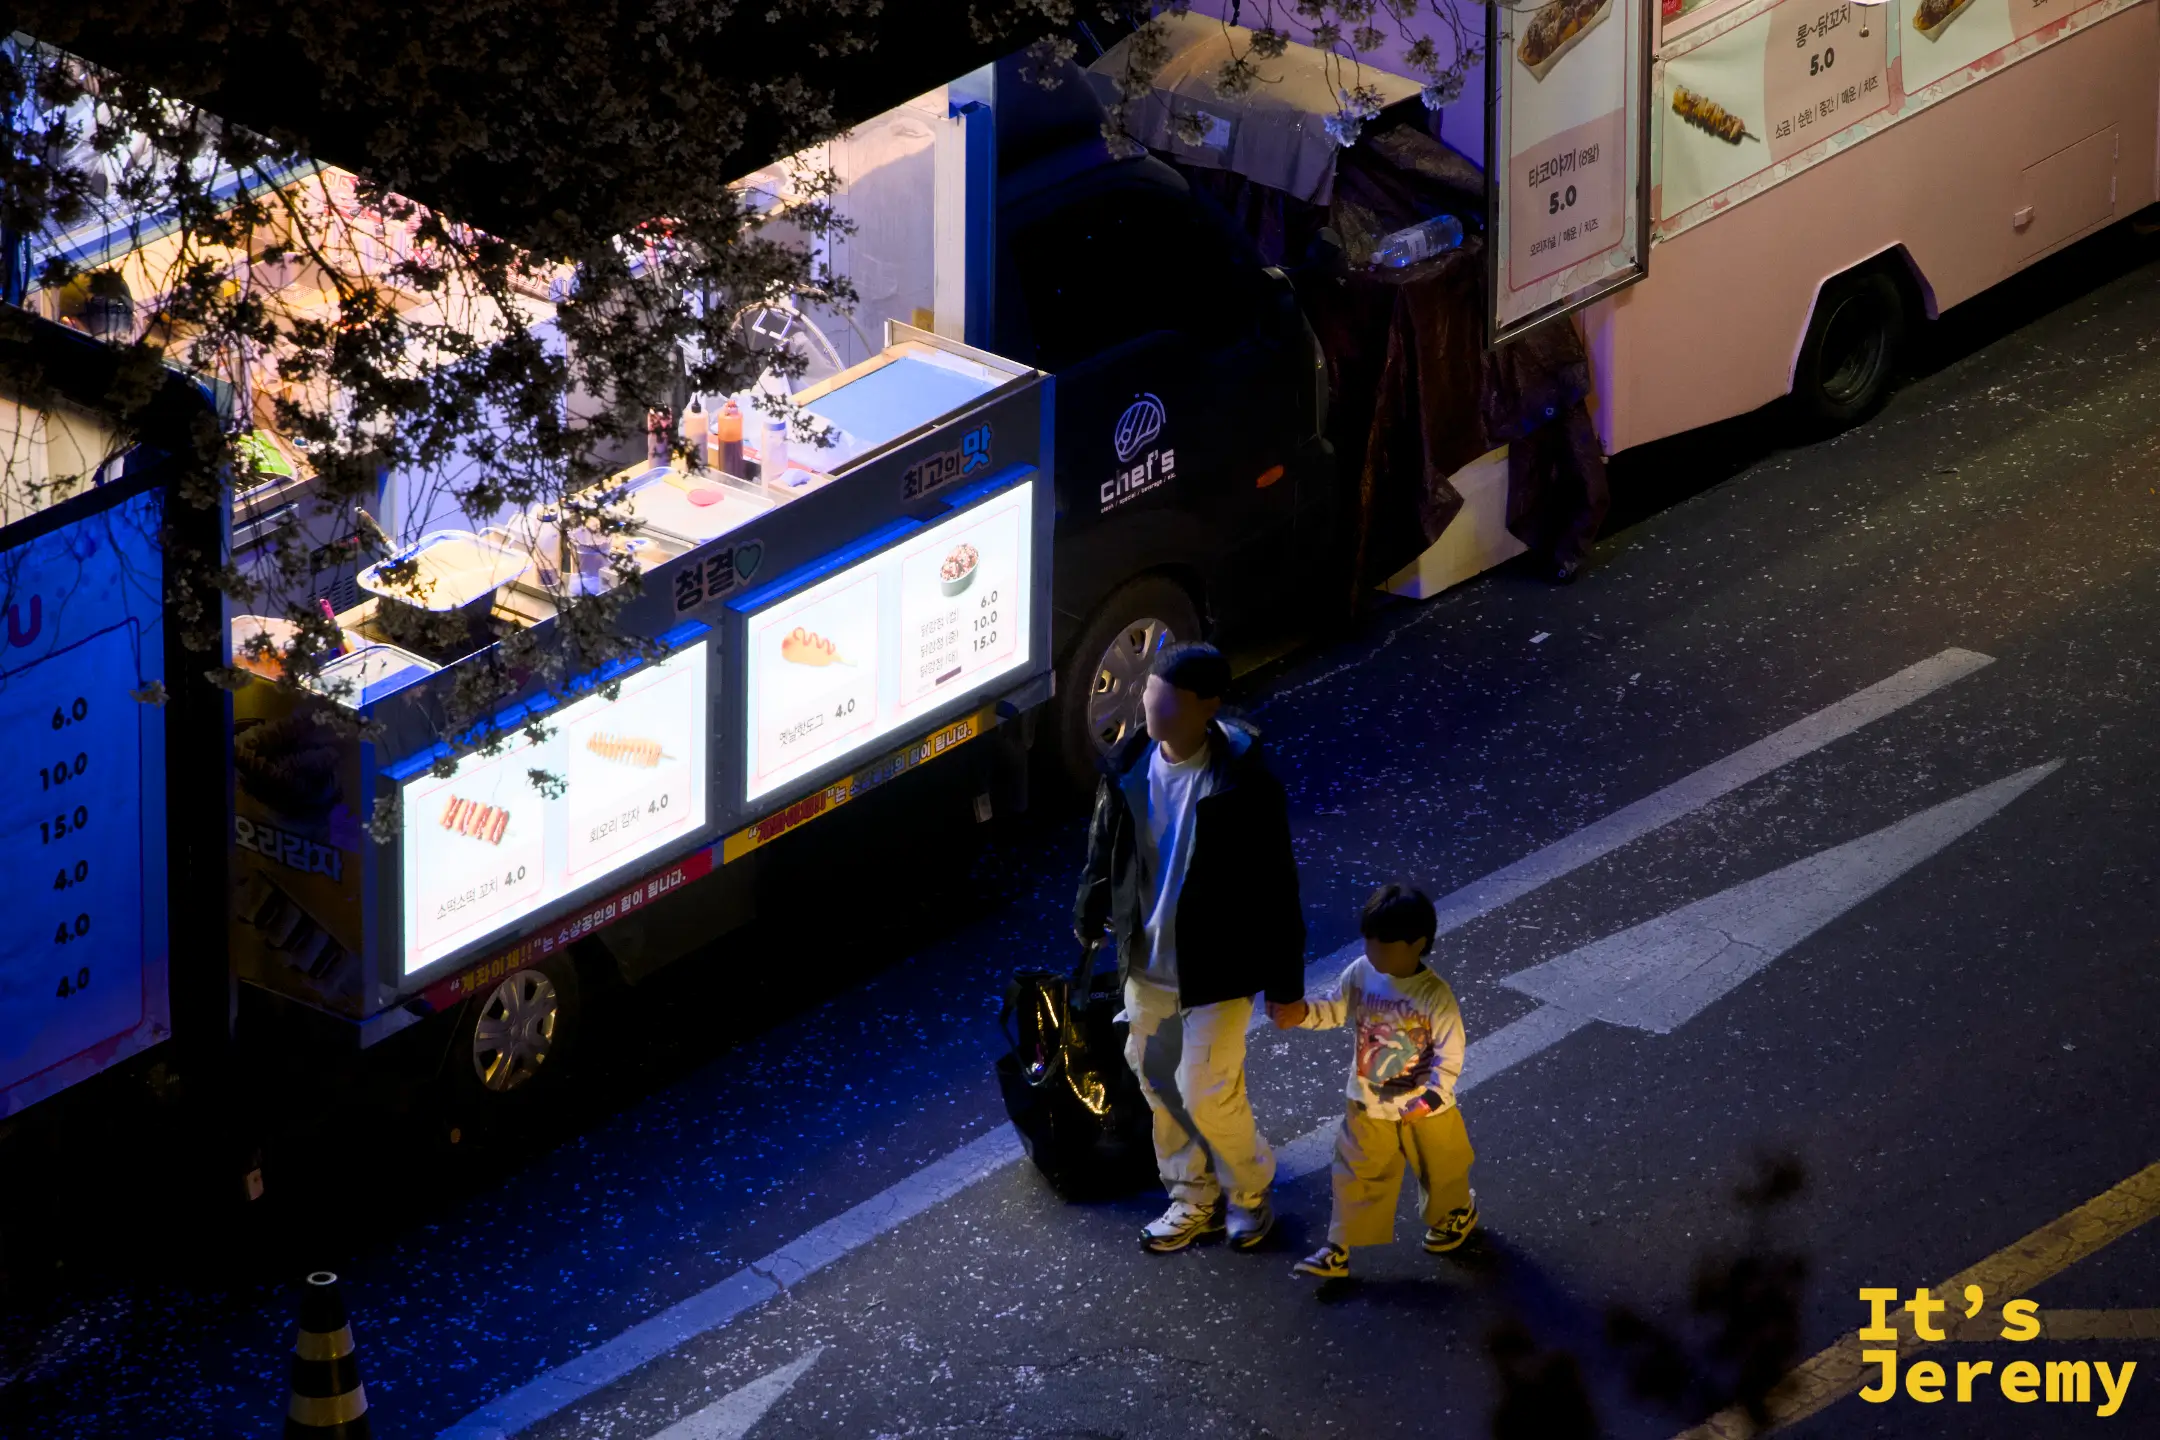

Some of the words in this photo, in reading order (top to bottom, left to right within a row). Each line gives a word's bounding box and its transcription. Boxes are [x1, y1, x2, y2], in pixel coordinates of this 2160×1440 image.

[1810, 47, 1835, 76] 5.0
[1776, 120, 1791, 139] 소금
[1798, 108, 1813, 128] 순한
[1820, 97, 1835, 117] 중간
[1841, 86, 1857, 104] 매운
[1864, 76, 1879, 92] 치즈
[1528, 148, 1577, 188] 타코야끼
[1578, 143, 1600, 168] (8알)
[1549, 185, 1577, 215] 5.0
[1530, 236, 1556, 257] 오리지널
[1563, 226, 1577, 242] 매운
[1584, 218, 1600, 232] 치즈
[903, 451, 960, 500] 최고의
[962, 423, 992, 473] 맛
[981, 590, 998, 609] 6.0
[974, 610, 998, 632] 10.0
[973, 630, 997, 652] 15.0
[52, 697, 88, 731] 6.0
[835, 697, 855, 718] 4.0
[39, 752, 88, 792] 10.0
[39, 805, 88, 845] 15.0
[621, 808, 640, 829] 감자
[648, 794, 669, 815] 4.0
[54, 860, 89, 891] 4.0
[503, 865, 526, 887] 4.0
[558, 902, 616, 944] 소상공인의
[621, 889, 643, 913] 힘이
[648, 868, 687, 899] 됩니다.
[54, 913, 91, 945] 4.0
[56, 967, 90, 999] 4.0
